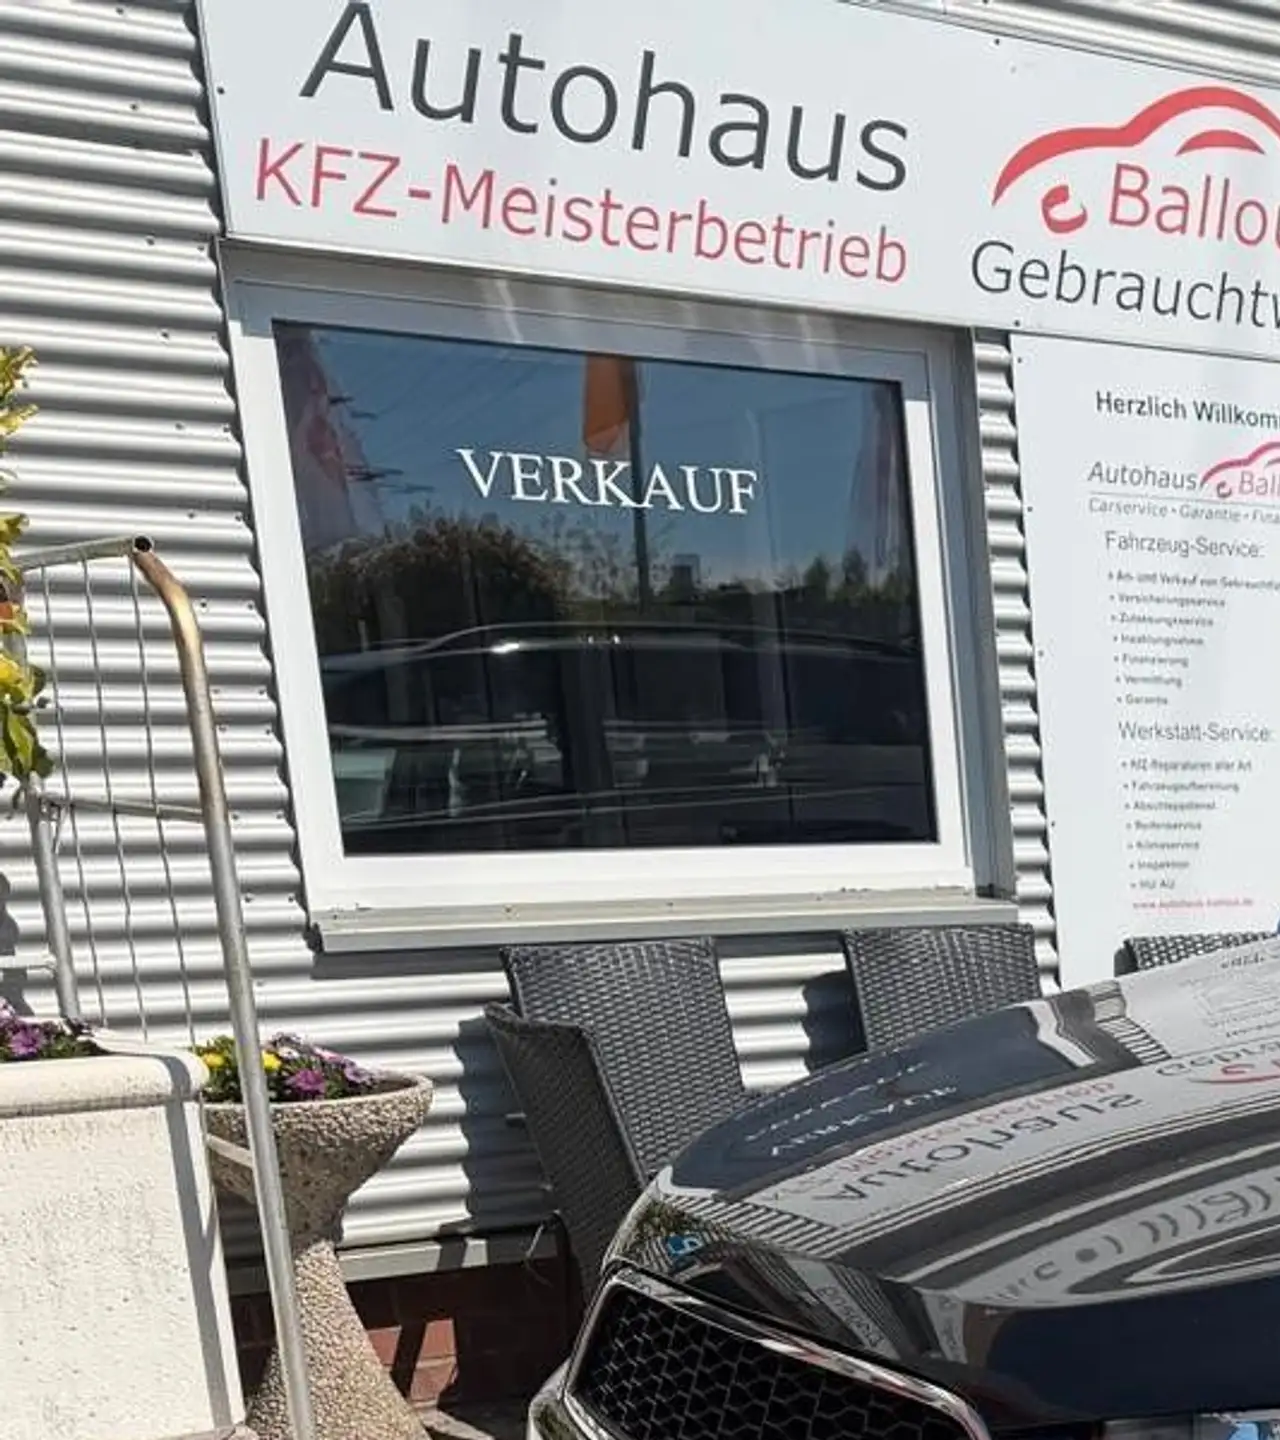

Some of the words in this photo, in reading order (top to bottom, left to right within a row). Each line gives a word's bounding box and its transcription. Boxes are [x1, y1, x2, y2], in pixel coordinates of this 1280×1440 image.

[300, 1, 910, 192] Autohaus
[256, 137, 908, 283] KFZ-Meisterbetrieb
[1095, 390, 1187, 420] Herzlich
[455, 448, 759, 514] VERKAUF
[1087, 461, 1197, 491] Autohaus
[1088, 498, 1168, 518] Carservice
[1179, 503, 1244, 524] Garantie
[1105, 530, 1266, 559] Fahrzeug-Service:
